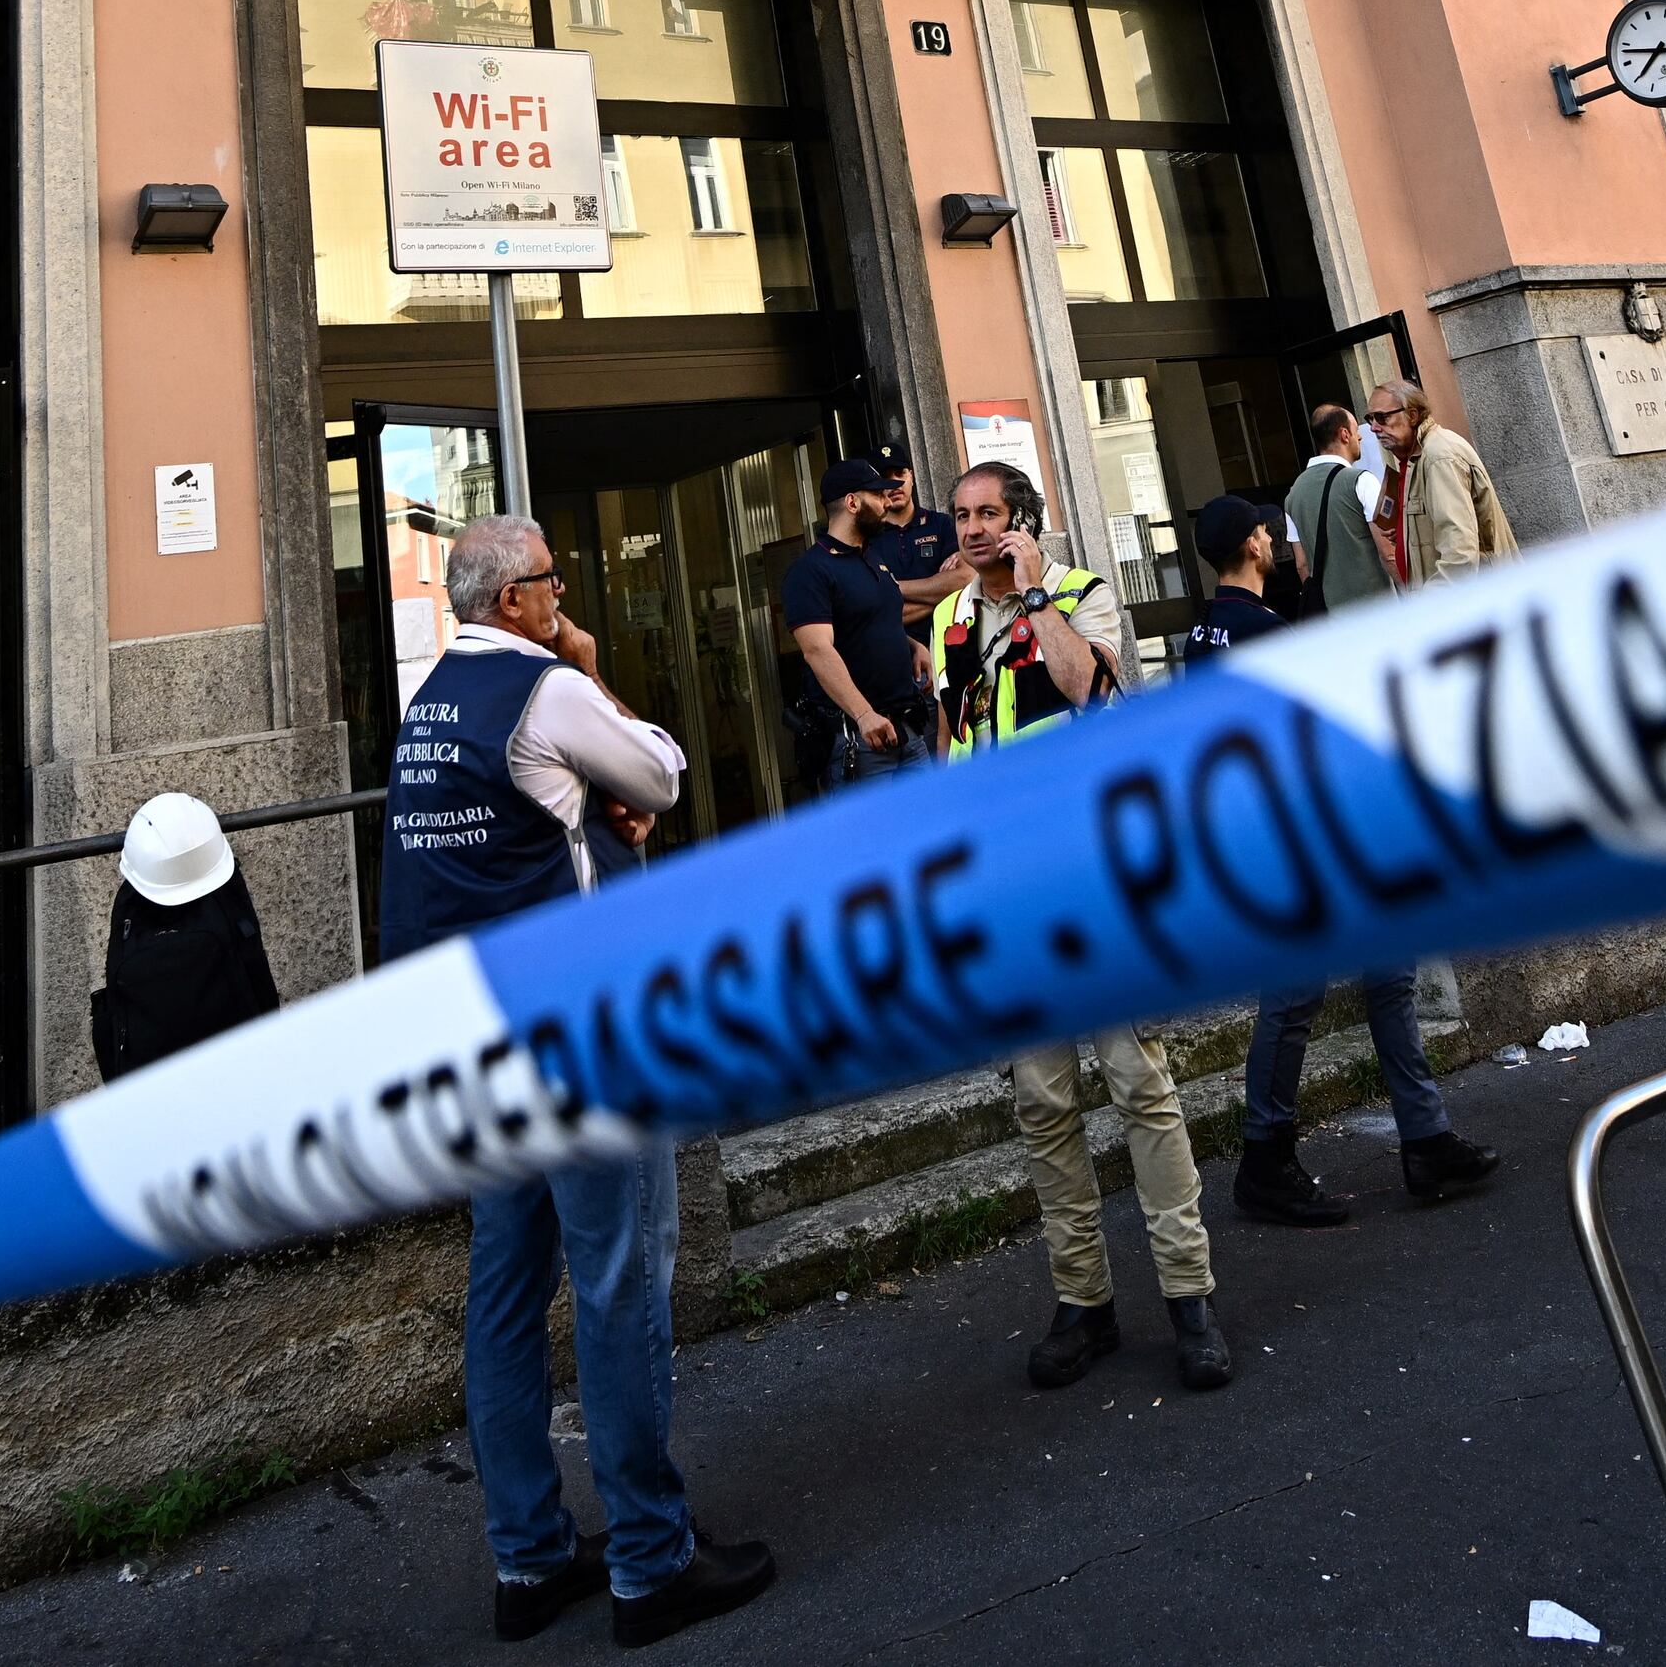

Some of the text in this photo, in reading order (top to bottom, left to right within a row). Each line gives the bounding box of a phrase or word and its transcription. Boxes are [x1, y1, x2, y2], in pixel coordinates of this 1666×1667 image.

[916, 25, 946, 51] 19
[432, 92, 548, 132] Wi-Fi
[439, 138, 552, 168] area
[461, 180, 541, 190] Open Wi-Fi Milano
[426, 243, 478, 252] partecipazione
[512, 242, 595, 253] Internet Explorer
[1616, 370, 1646, 384] CASA
[1651, 367, 1663, 382] DI
[1635, 403, 1659, 417] PER
[914, 534, 938, 546] POLIZIA
[405, 703, 459, 723] PROCURA
[412, 726, 432, 736] DELLA
[399, 768, 437, 784] MILANO
[408, 805, 496, 828] GIUDIZIARIA
